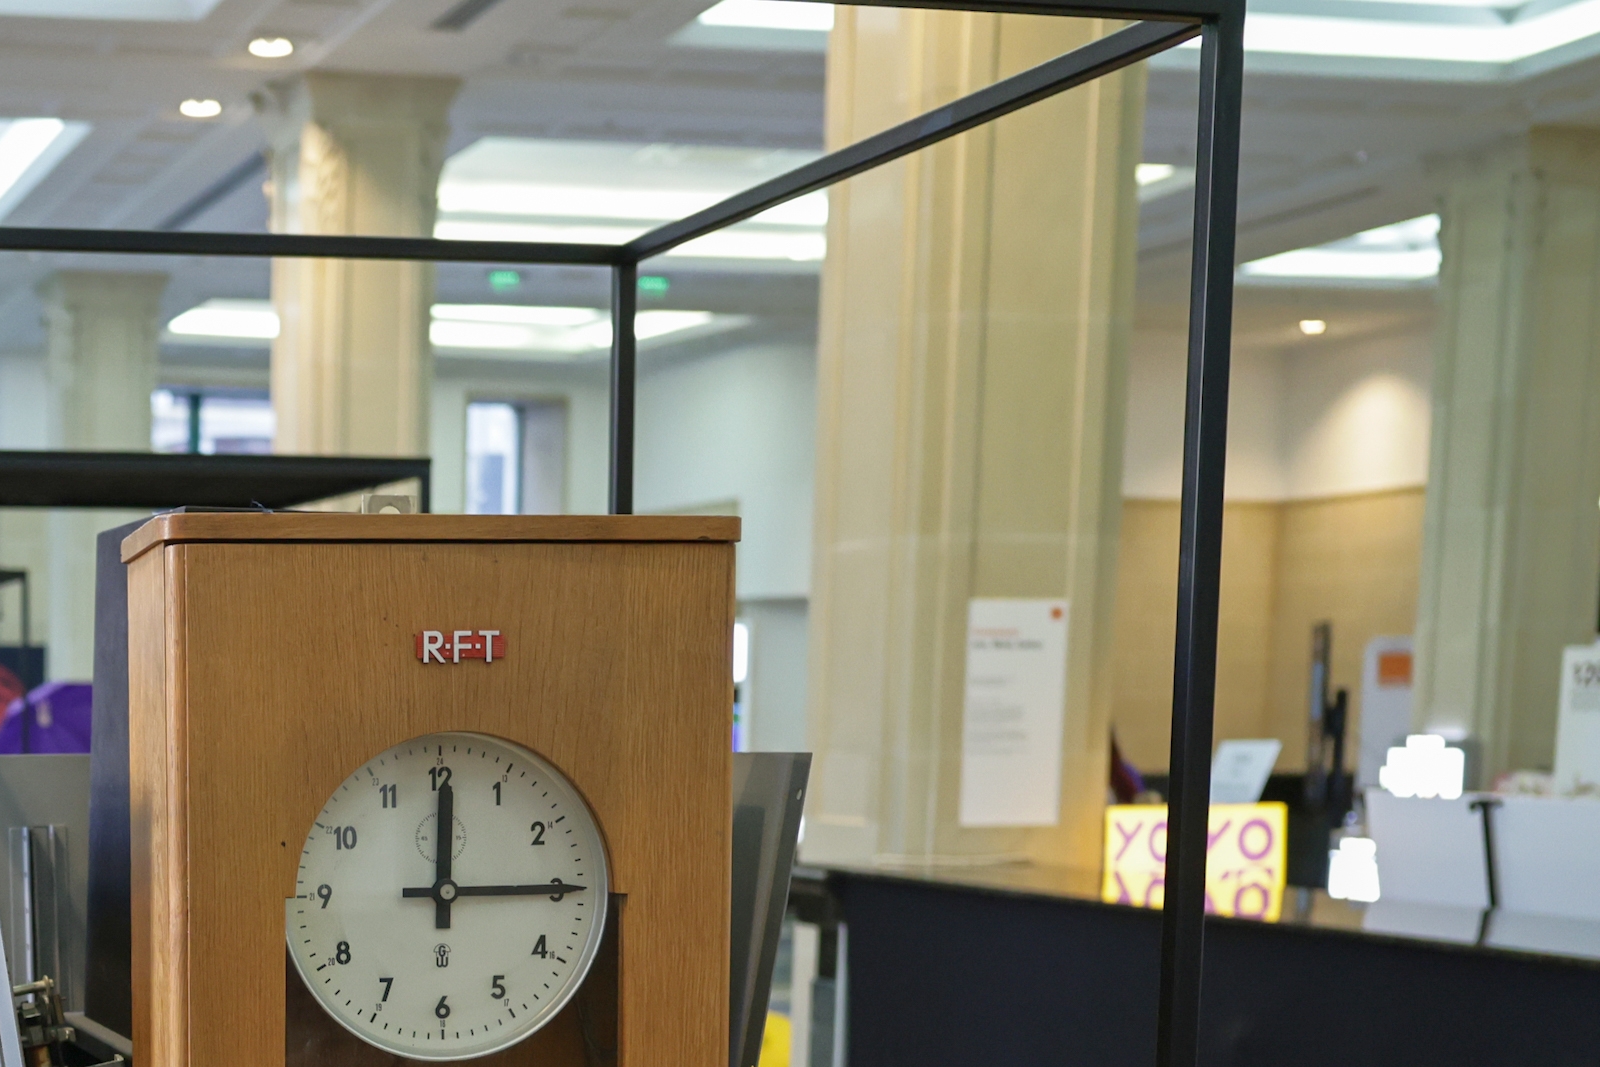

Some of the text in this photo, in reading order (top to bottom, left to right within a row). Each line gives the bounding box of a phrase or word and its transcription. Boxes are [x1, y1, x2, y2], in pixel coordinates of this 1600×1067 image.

[428, 766, 452, 792] 12
[379, 784, 397, 809] 11
[492, 781, 501, 806] 1
[333, 825, 358, 851] 10
[530, 821, 546, 846] 2
[317, 883, 333, 909] 9
[549, 877, 565, 903] 3
[335, 940, 352, 965] 8
[531, 934, 548, 959] 4
[379, 977, 394, 1003] 7
[490, 975, 506, 1000] 5
[434, 995, 451, 1020] 6
